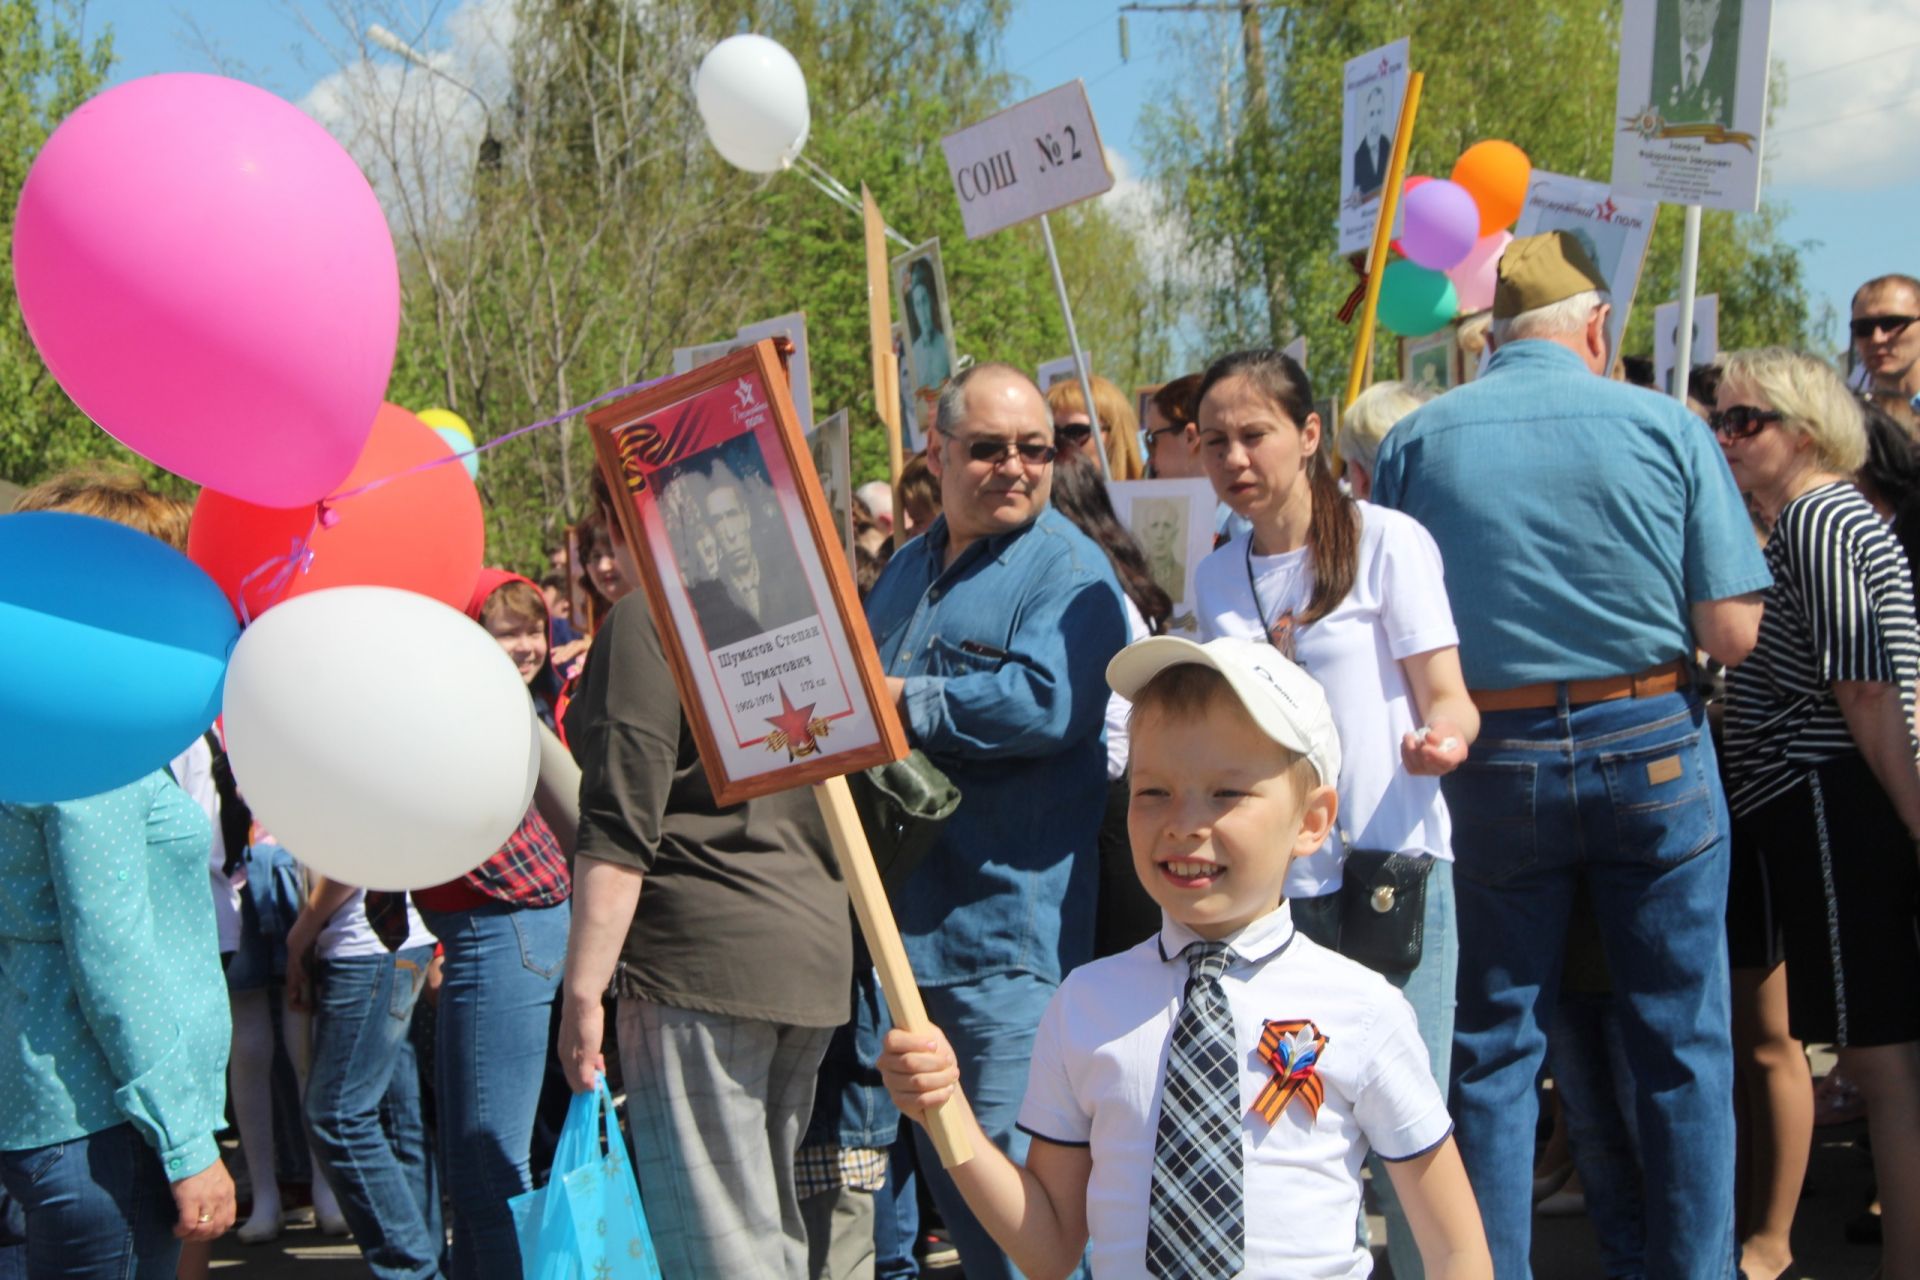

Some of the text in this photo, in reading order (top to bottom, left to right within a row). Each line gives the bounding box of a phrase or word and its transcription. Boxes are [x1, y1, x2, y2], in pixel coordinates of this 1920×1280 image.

[958, 150, 1017, 202] СОШ
[718, 625, 820, 669] Шуматов Степан
[741, 655, 812, 687] Шуматович
